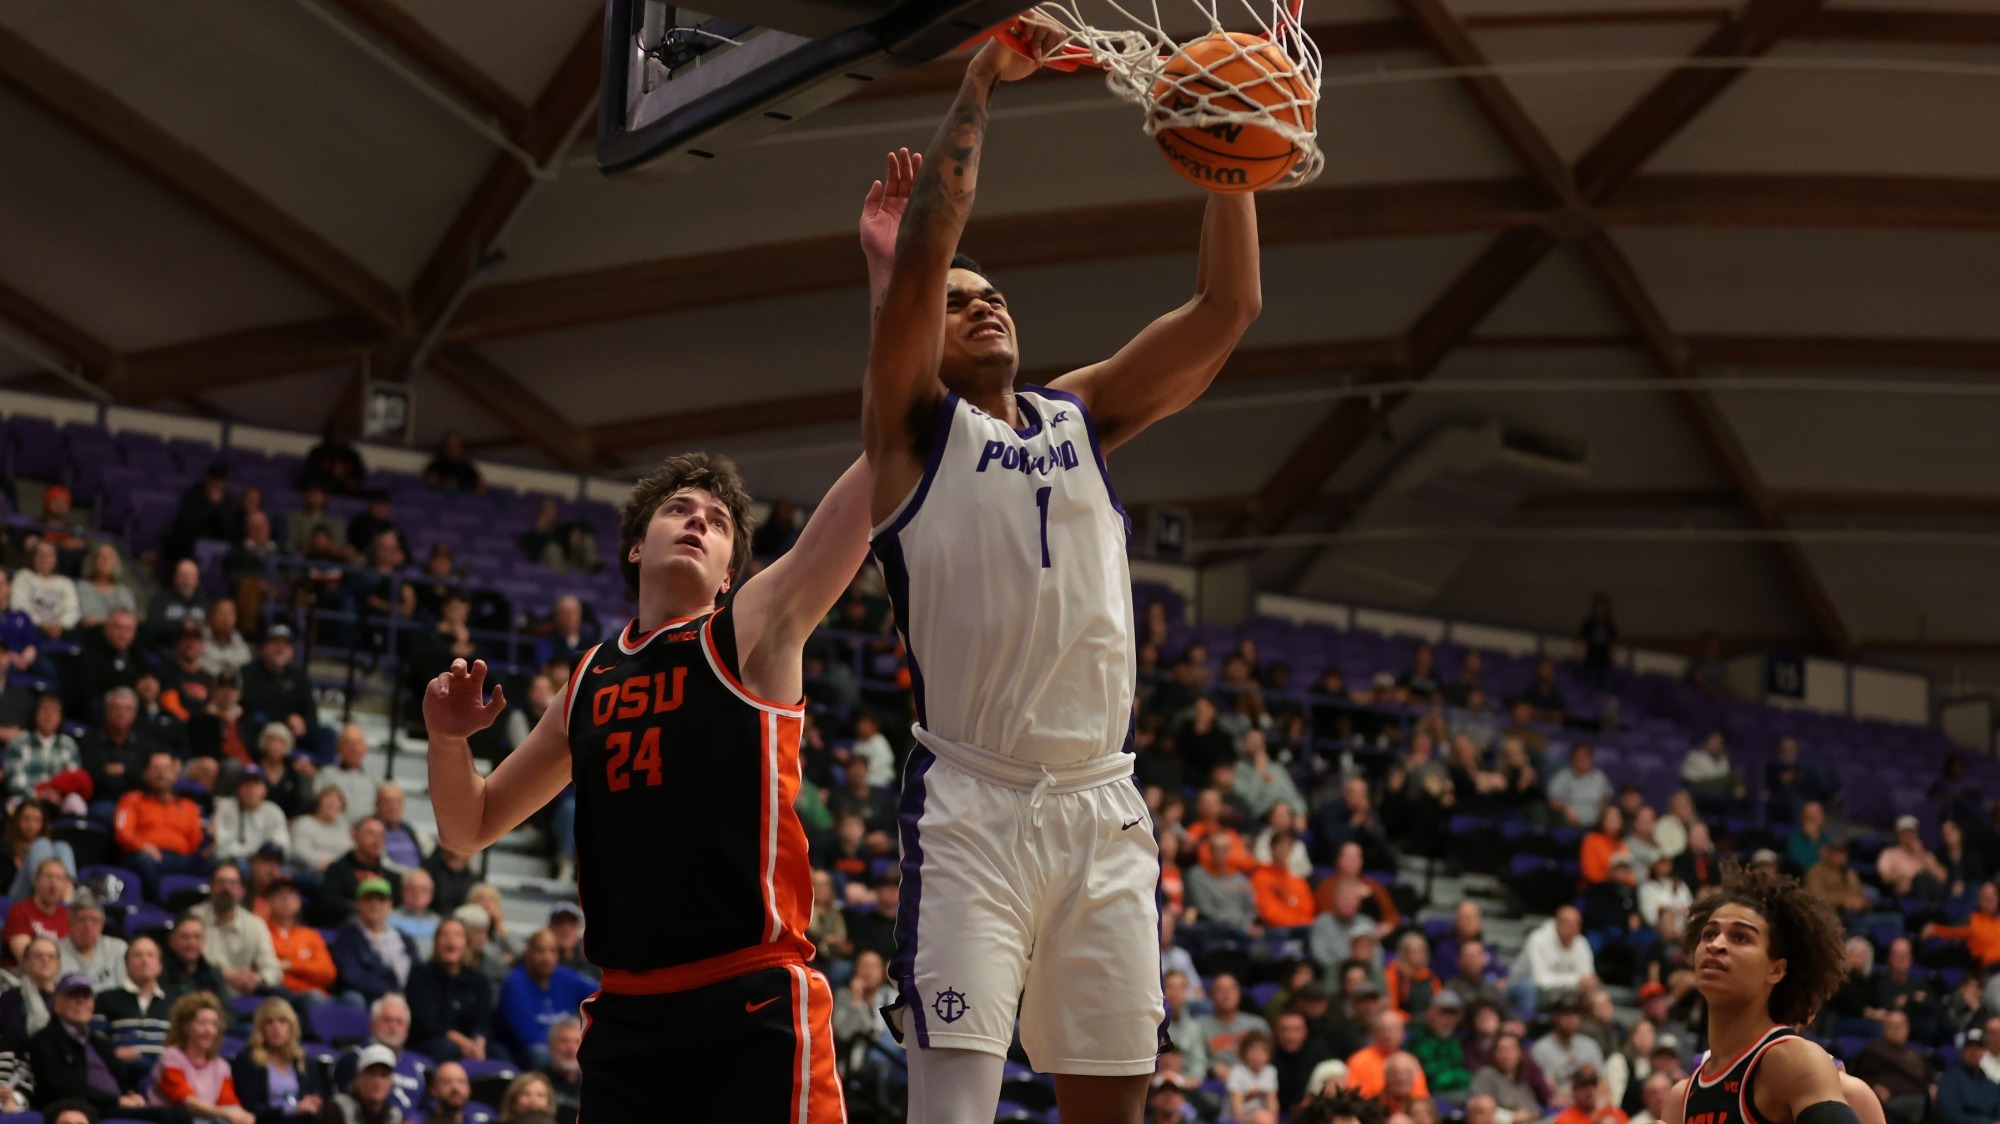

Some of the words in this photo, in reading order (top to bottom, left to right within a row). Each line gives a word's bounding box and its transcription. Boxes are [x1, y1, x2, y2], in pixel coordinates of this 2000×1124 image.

[1036, 486, 1052, 568] 1
[667, 630, 698, 643] WCC
[593, 667, 687, 727] OSU
[606, 727, 662, 792] 24
